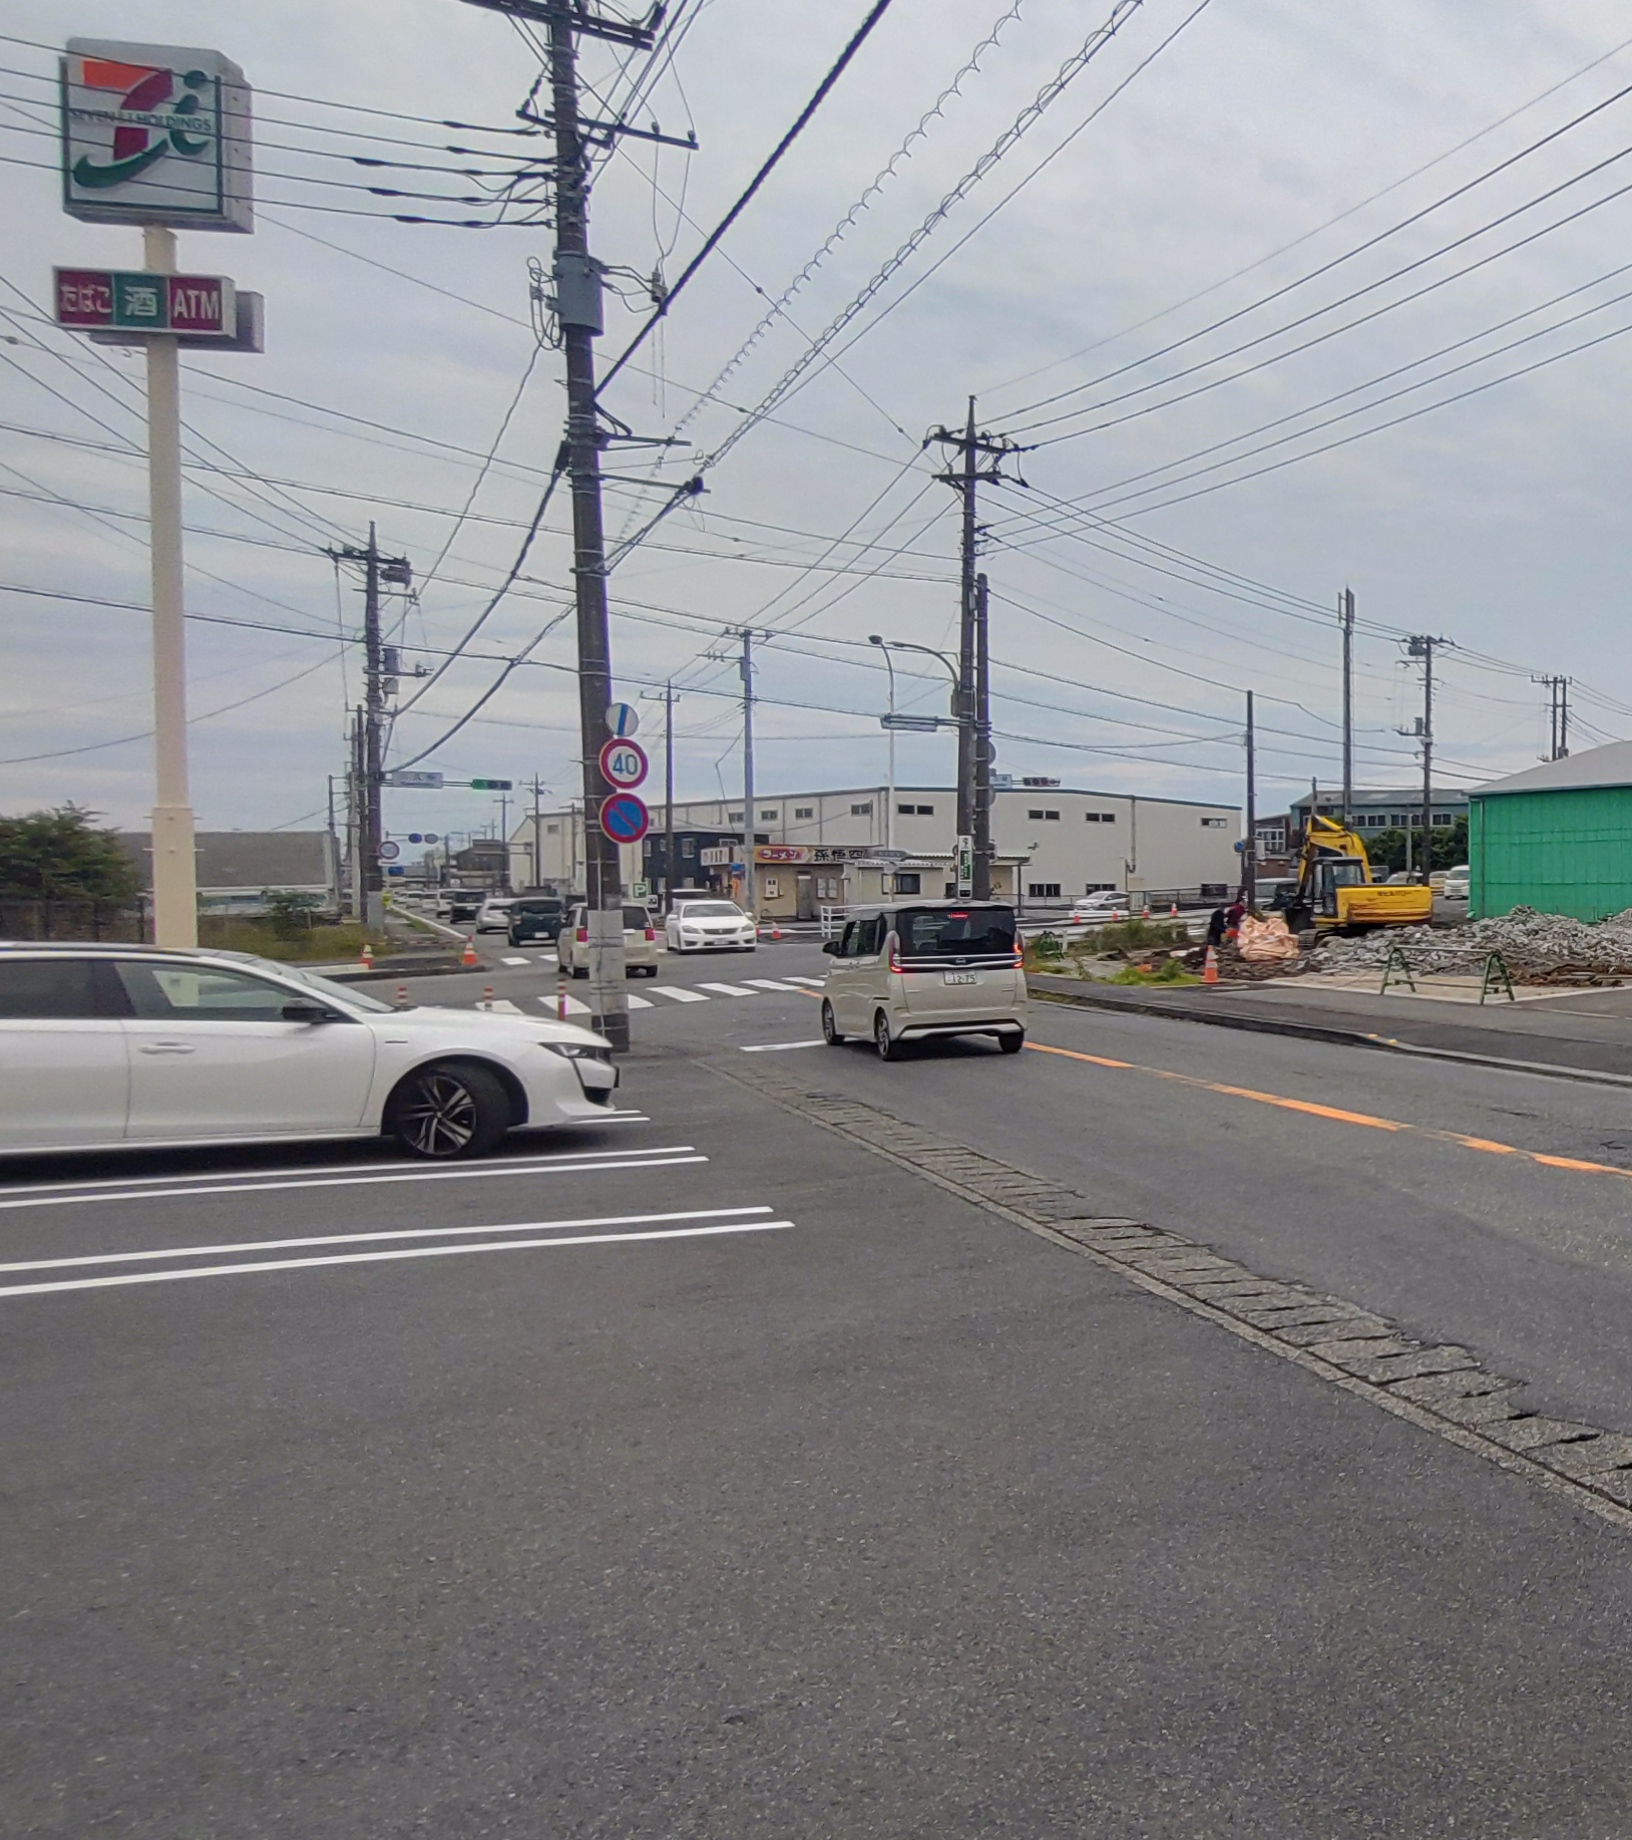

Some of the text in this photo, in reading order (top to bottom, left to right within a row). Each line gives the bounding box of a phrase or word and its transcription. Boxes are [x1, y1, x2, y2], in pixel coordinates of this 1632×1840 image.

[60, 284, 113, 314] たばこ
[125, 286, 159, 317] 酒
[173, 288, 219, 320] ATM
[612, 753, 638, 775] 40
[762, 849, 799, 860] ラーメン
